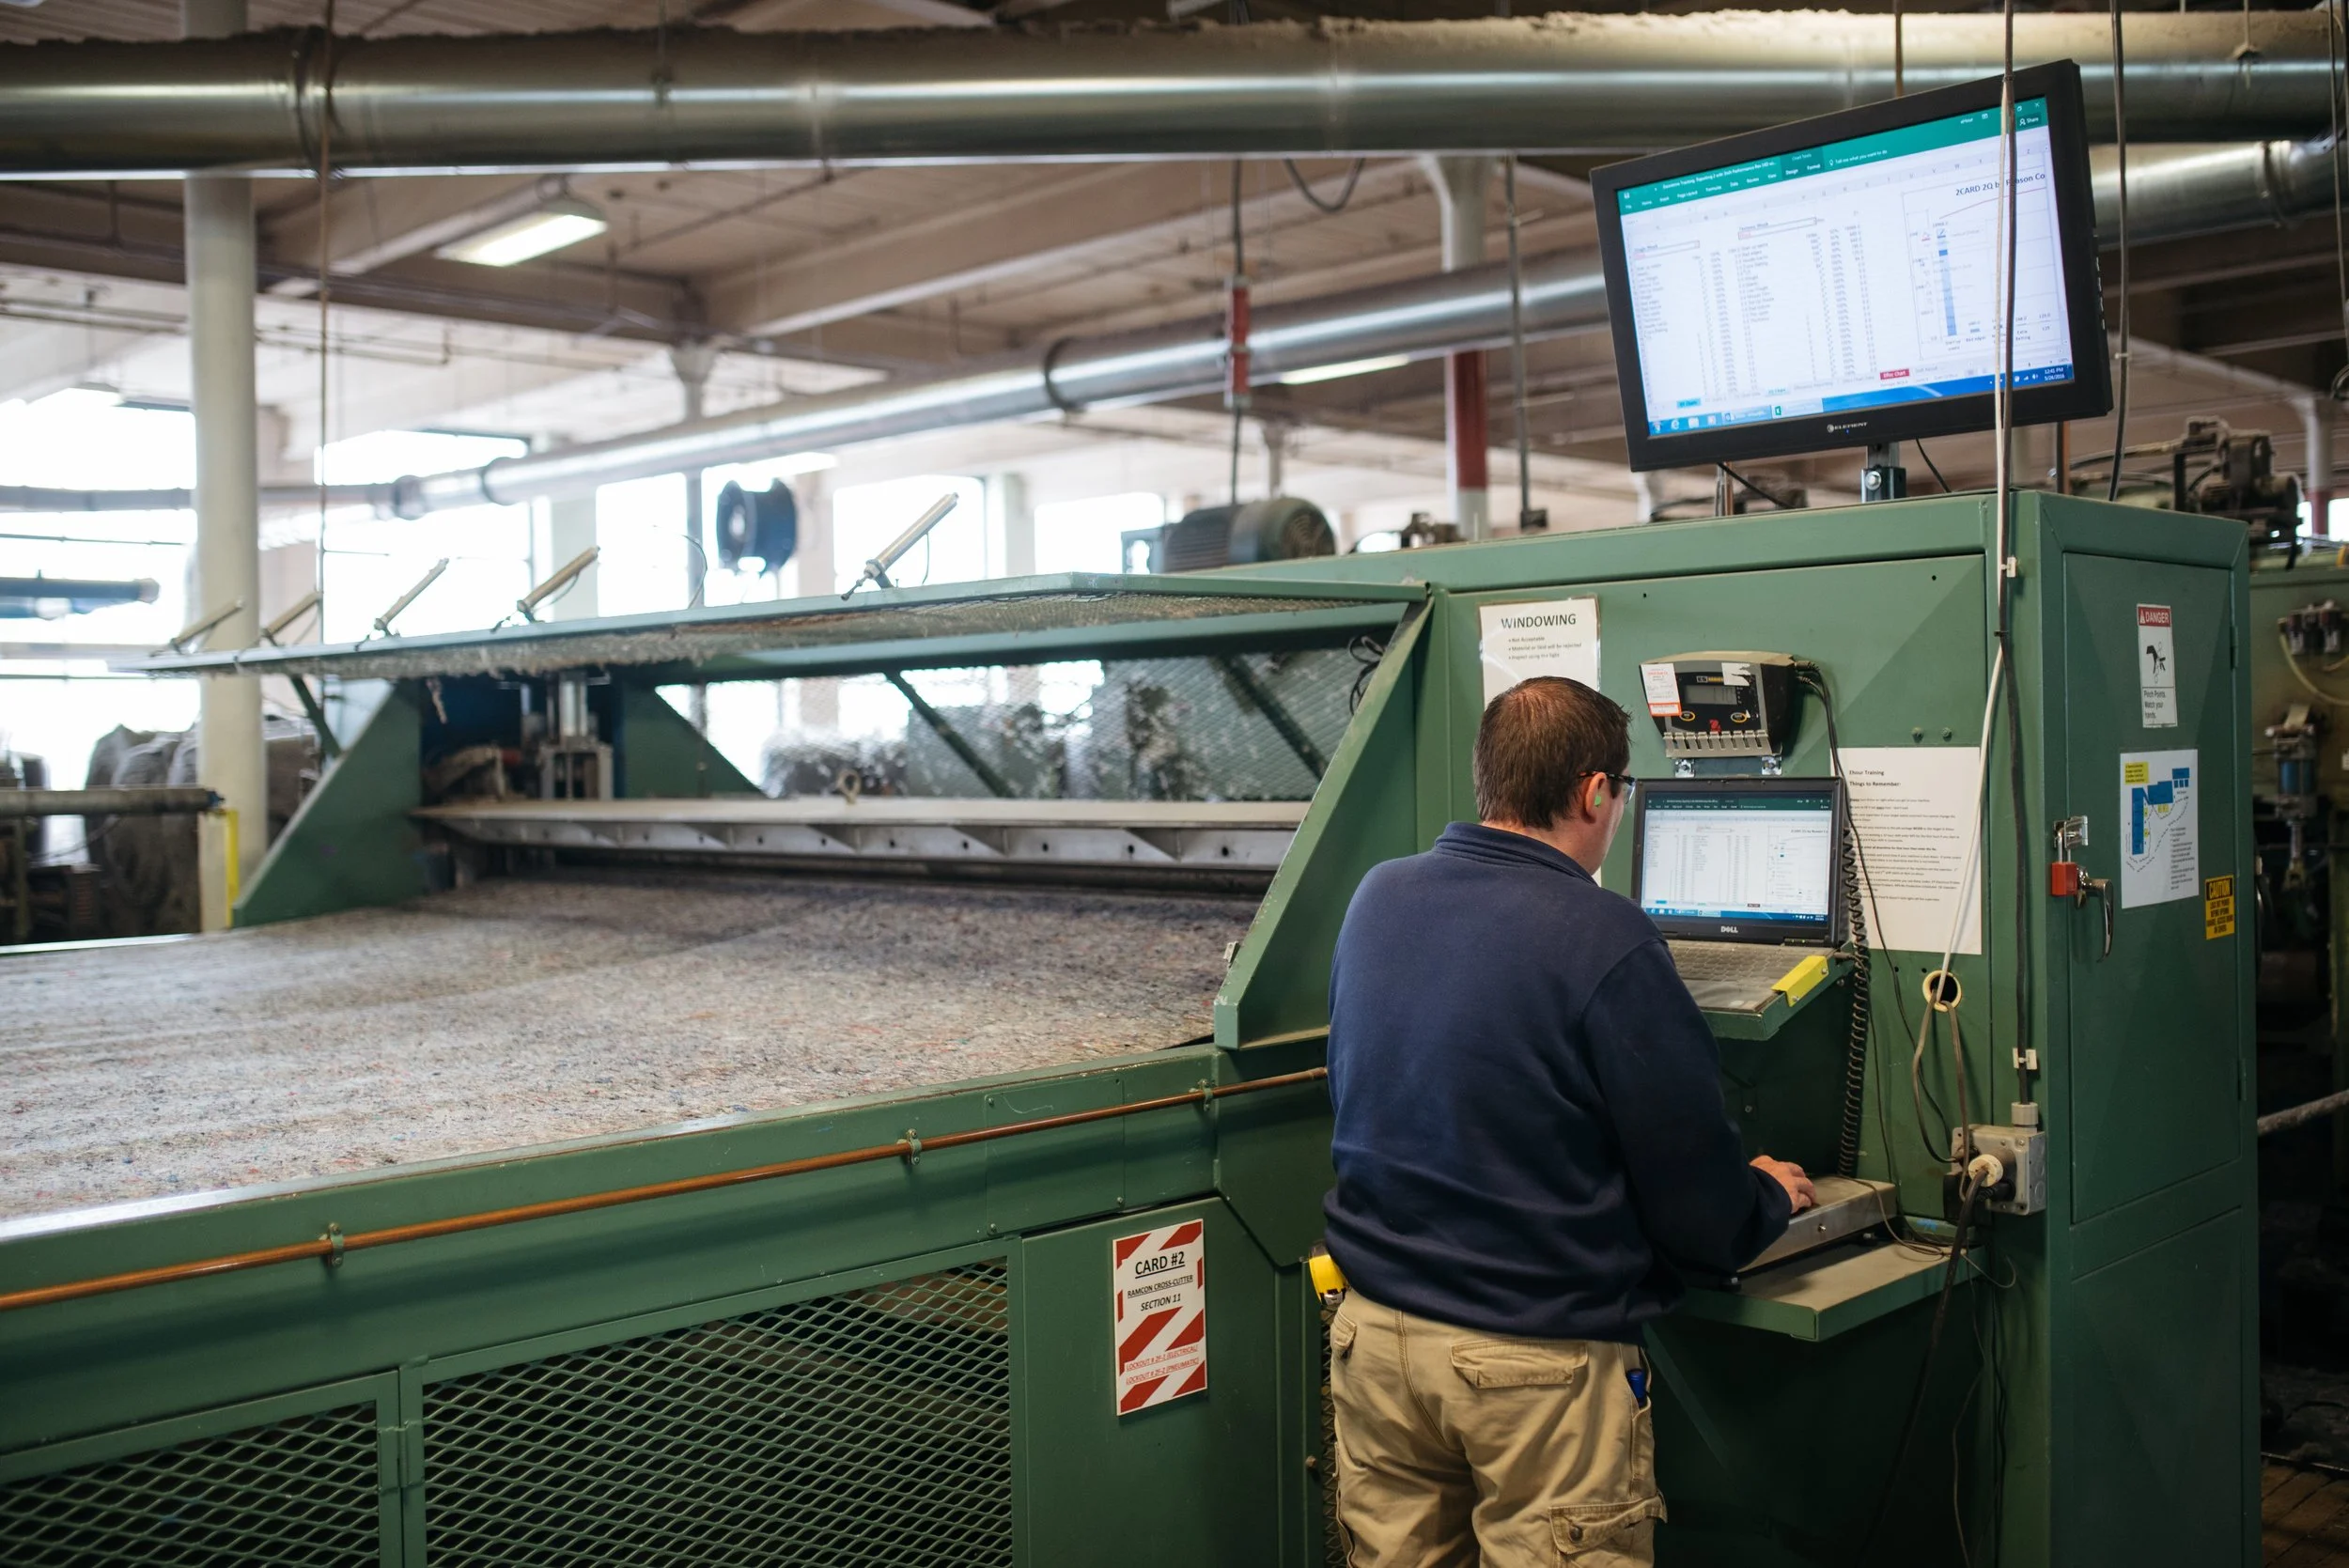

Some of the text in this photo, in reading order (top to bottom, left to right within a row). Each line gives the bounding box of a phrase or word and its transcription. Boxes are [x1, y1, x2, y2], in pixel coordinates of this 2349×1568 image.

[1955, 185, 1981, 196] 2CARD
[1983, 182, 1994, 192] 2Q
[2034, 172, 2046, 180] Co
[1501, 613, 1577, 629] WINDOWING
[2145, 612, 2170, 624] DANGER
[2144, 690, 2154, 698] Pinch
[2209, 878, 2230, 899] CAUTION
[1135, 1251, 1186, 1275] CARD #2
[1128, 1275, 1193, 1296] RAMCON CROSS-CUTTER
[1141, 1294, 1181, 1312] SECTION 11
[1127, 1358, 1150, 1371] LOCKOUT
[1127, 1372, 1150, 1385] LOCKOUT
